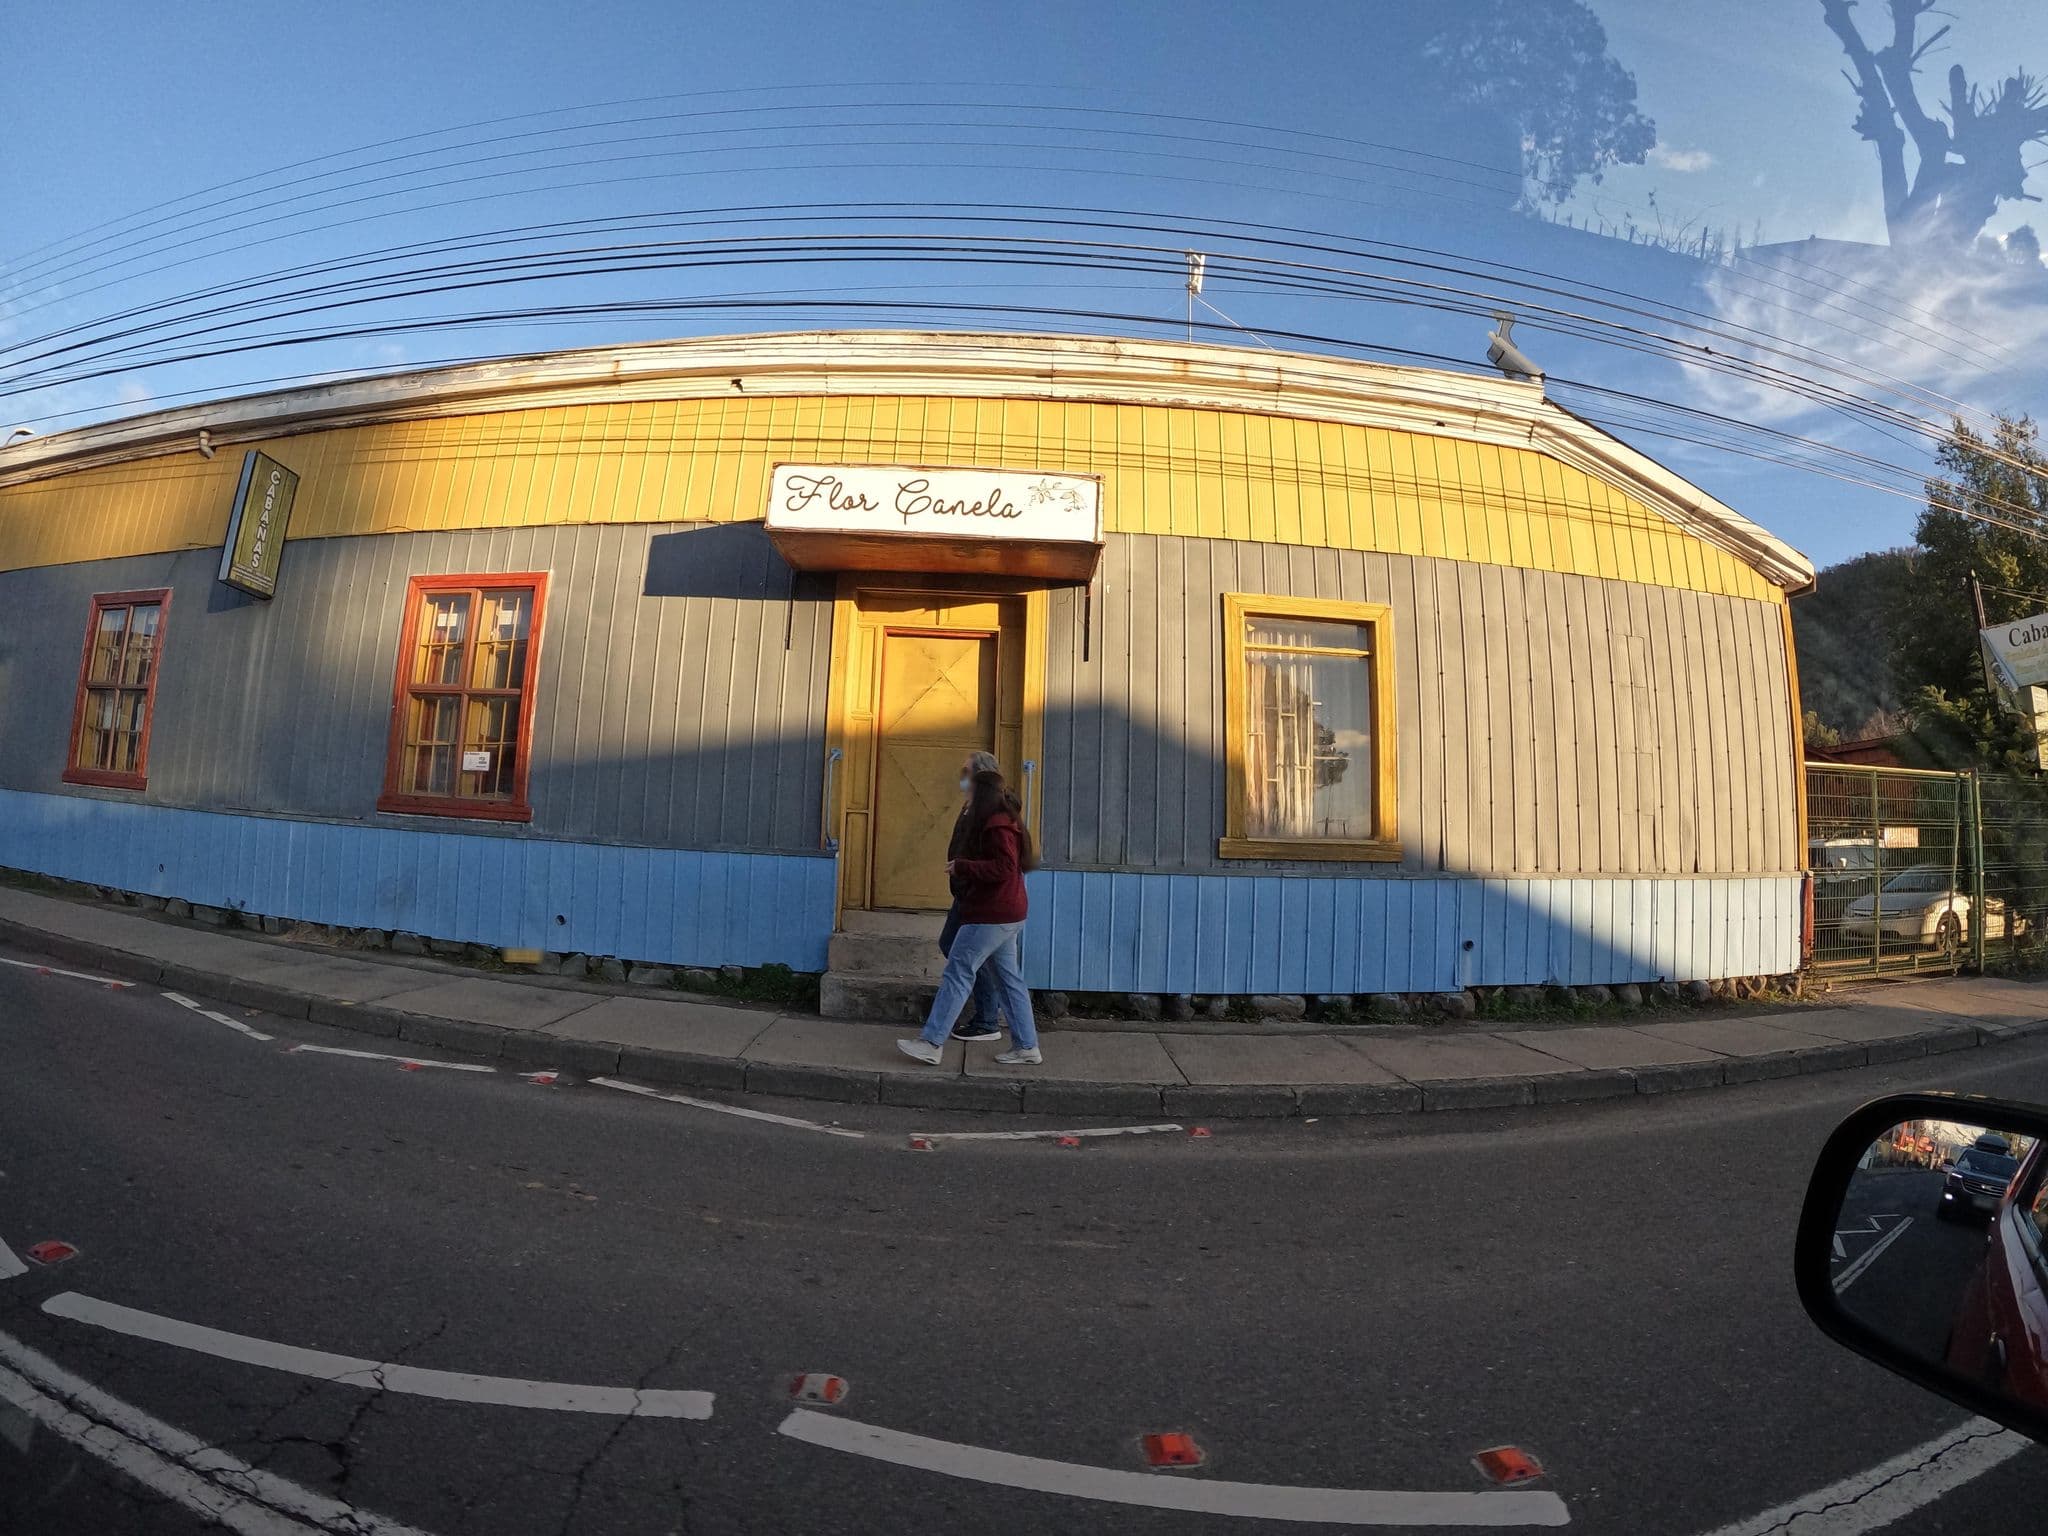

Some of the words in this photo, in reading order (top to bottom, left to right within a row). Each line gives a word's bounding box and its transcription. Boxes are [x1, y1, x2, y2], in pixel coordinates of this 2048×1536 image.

[251, 470, 281, 569] CABAÑAS
[785, 475, 879, 512] Flor
[894, 478, 1023, 525] Canela
